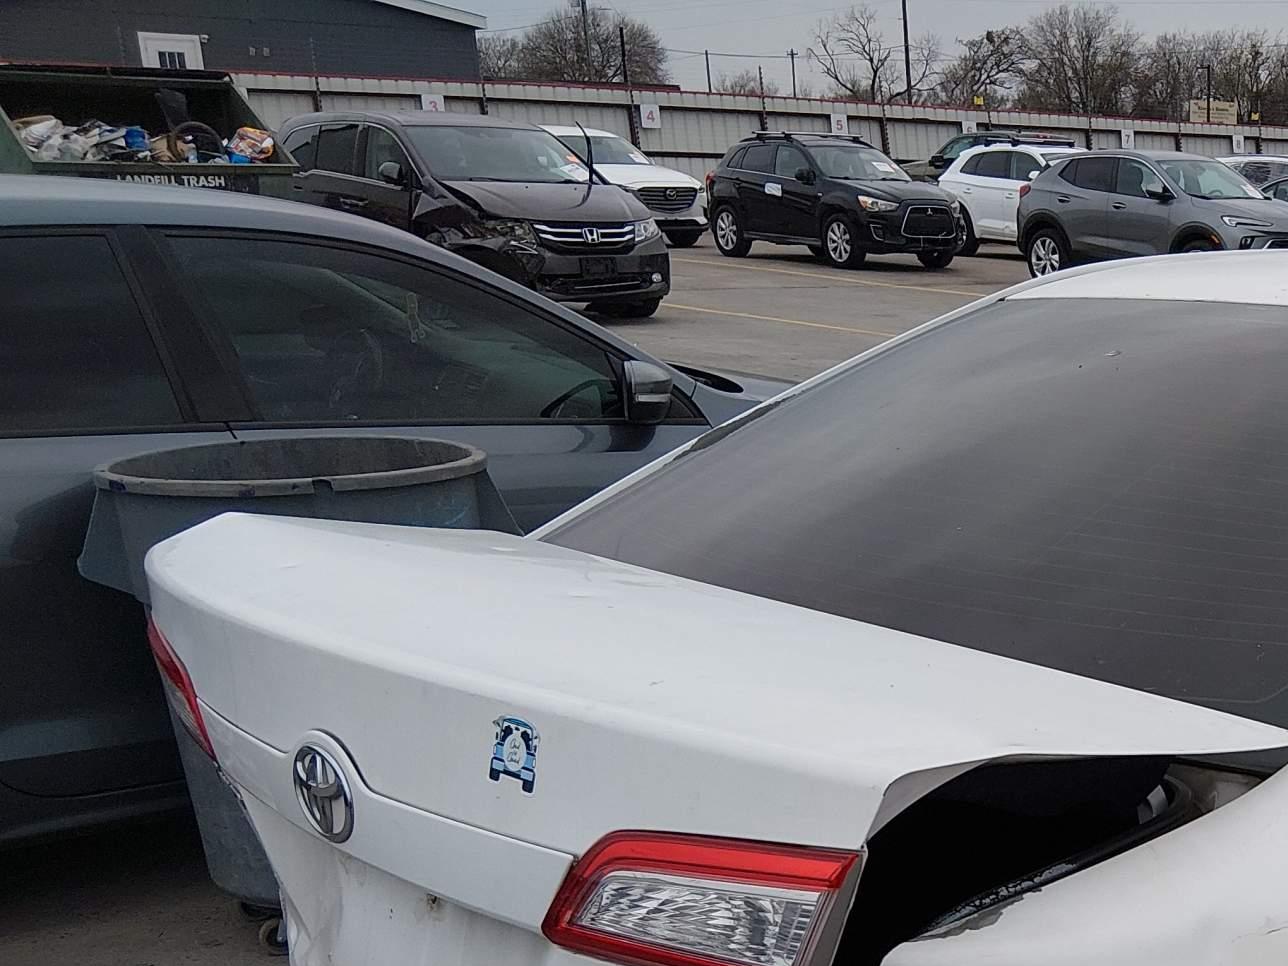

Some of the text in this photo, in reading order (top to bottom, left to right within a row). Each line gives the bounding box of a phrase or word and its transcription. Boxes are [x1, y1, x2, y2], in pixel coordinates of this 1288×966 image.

[647, 110, 655, 122] 4
[836, 119, 843, 131] 5
[1125, 134, 1131, 144] 7
[182, 175, 225, 188] TRASH
